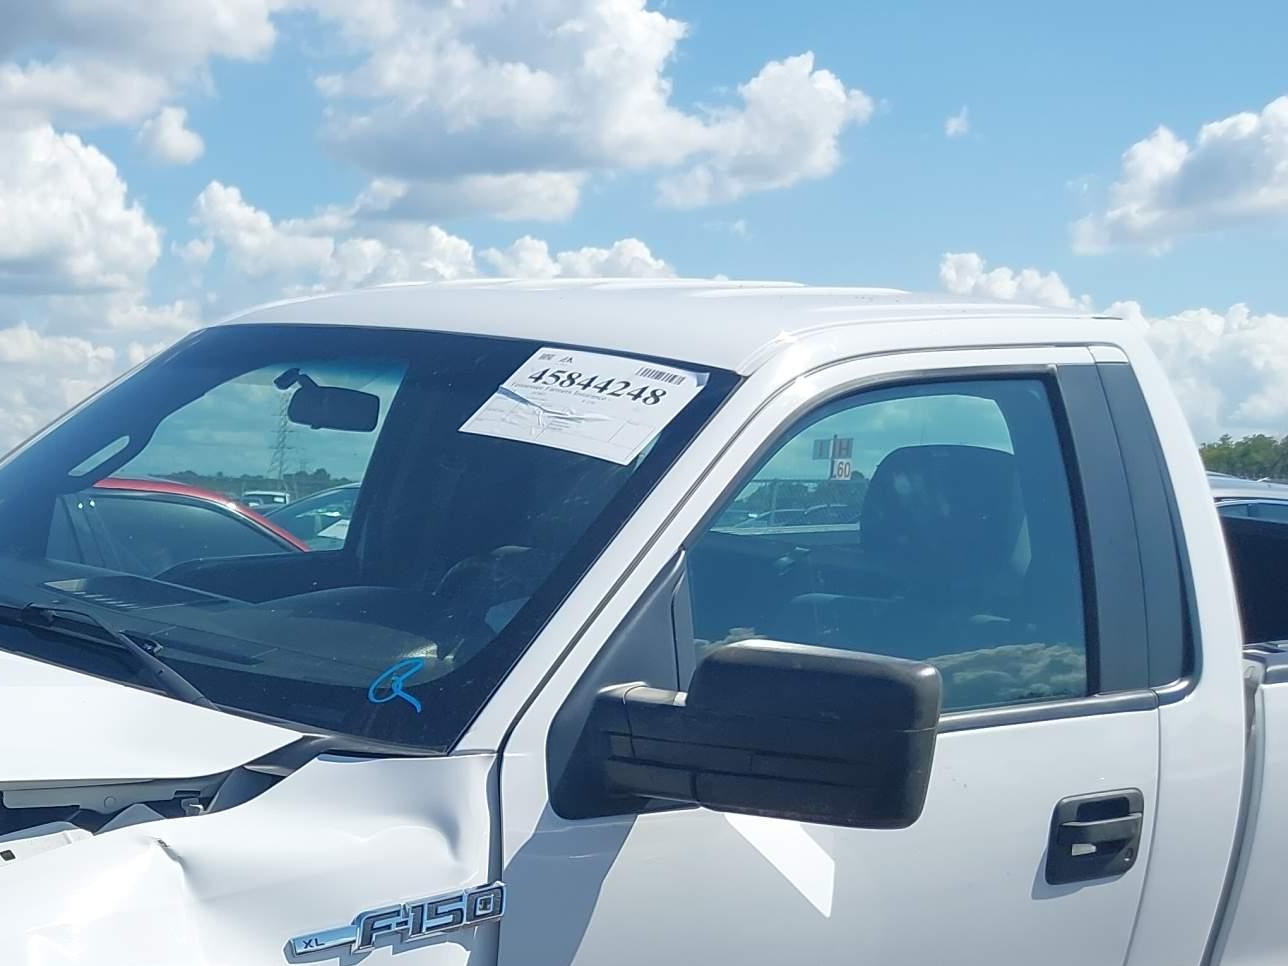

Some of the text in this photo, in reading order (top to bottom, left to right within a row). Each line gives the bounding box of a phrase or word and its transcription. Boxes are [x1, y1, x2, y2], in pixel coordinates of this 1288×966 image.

[528, 367, 667, 406] 45844248
[302, 882, 505, 954] XL F-150
